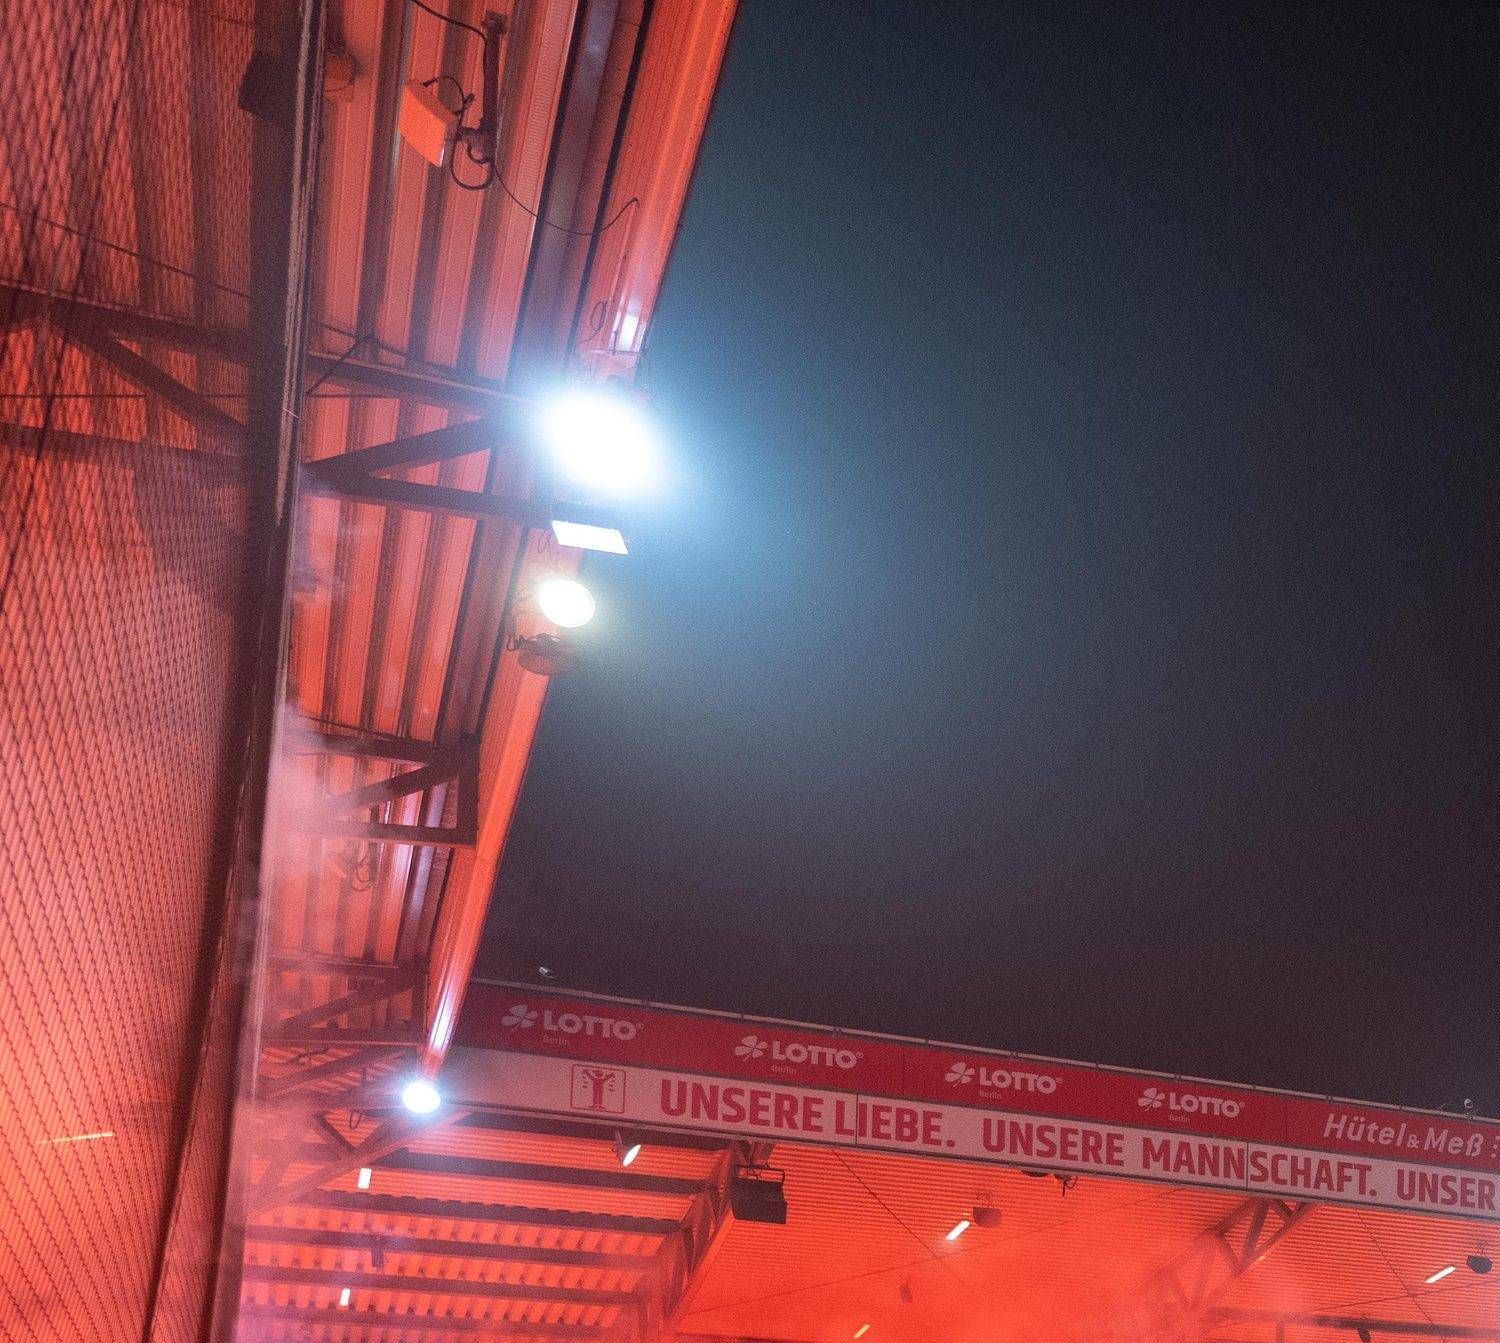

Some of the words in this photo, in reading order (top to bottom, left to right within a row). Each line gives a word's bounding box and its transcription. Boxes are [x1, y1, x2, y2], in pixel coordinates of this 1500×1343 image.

[543, 1009, 638, 1042] LOTTO
[543, 1035, 570, 1047] Berlin
[772, 1040, 858, 1070] LOTTO
[979, 1066, 1058, 1095] LOTTO
[979, 1089, 1003, 1100] Berlin
[1169, 1092, 1241, 1119] LOTTO
[660, 1078, 826, 1133] UNSERE
[834, 1099, 957, 1149] LIEBE.
[982, 1117, 1126, 1167] UNSERE
[1141, 1136, 1378, 1198] MANNSCHAFT.
[1396, 1168, 1497, 1212] UNSER
